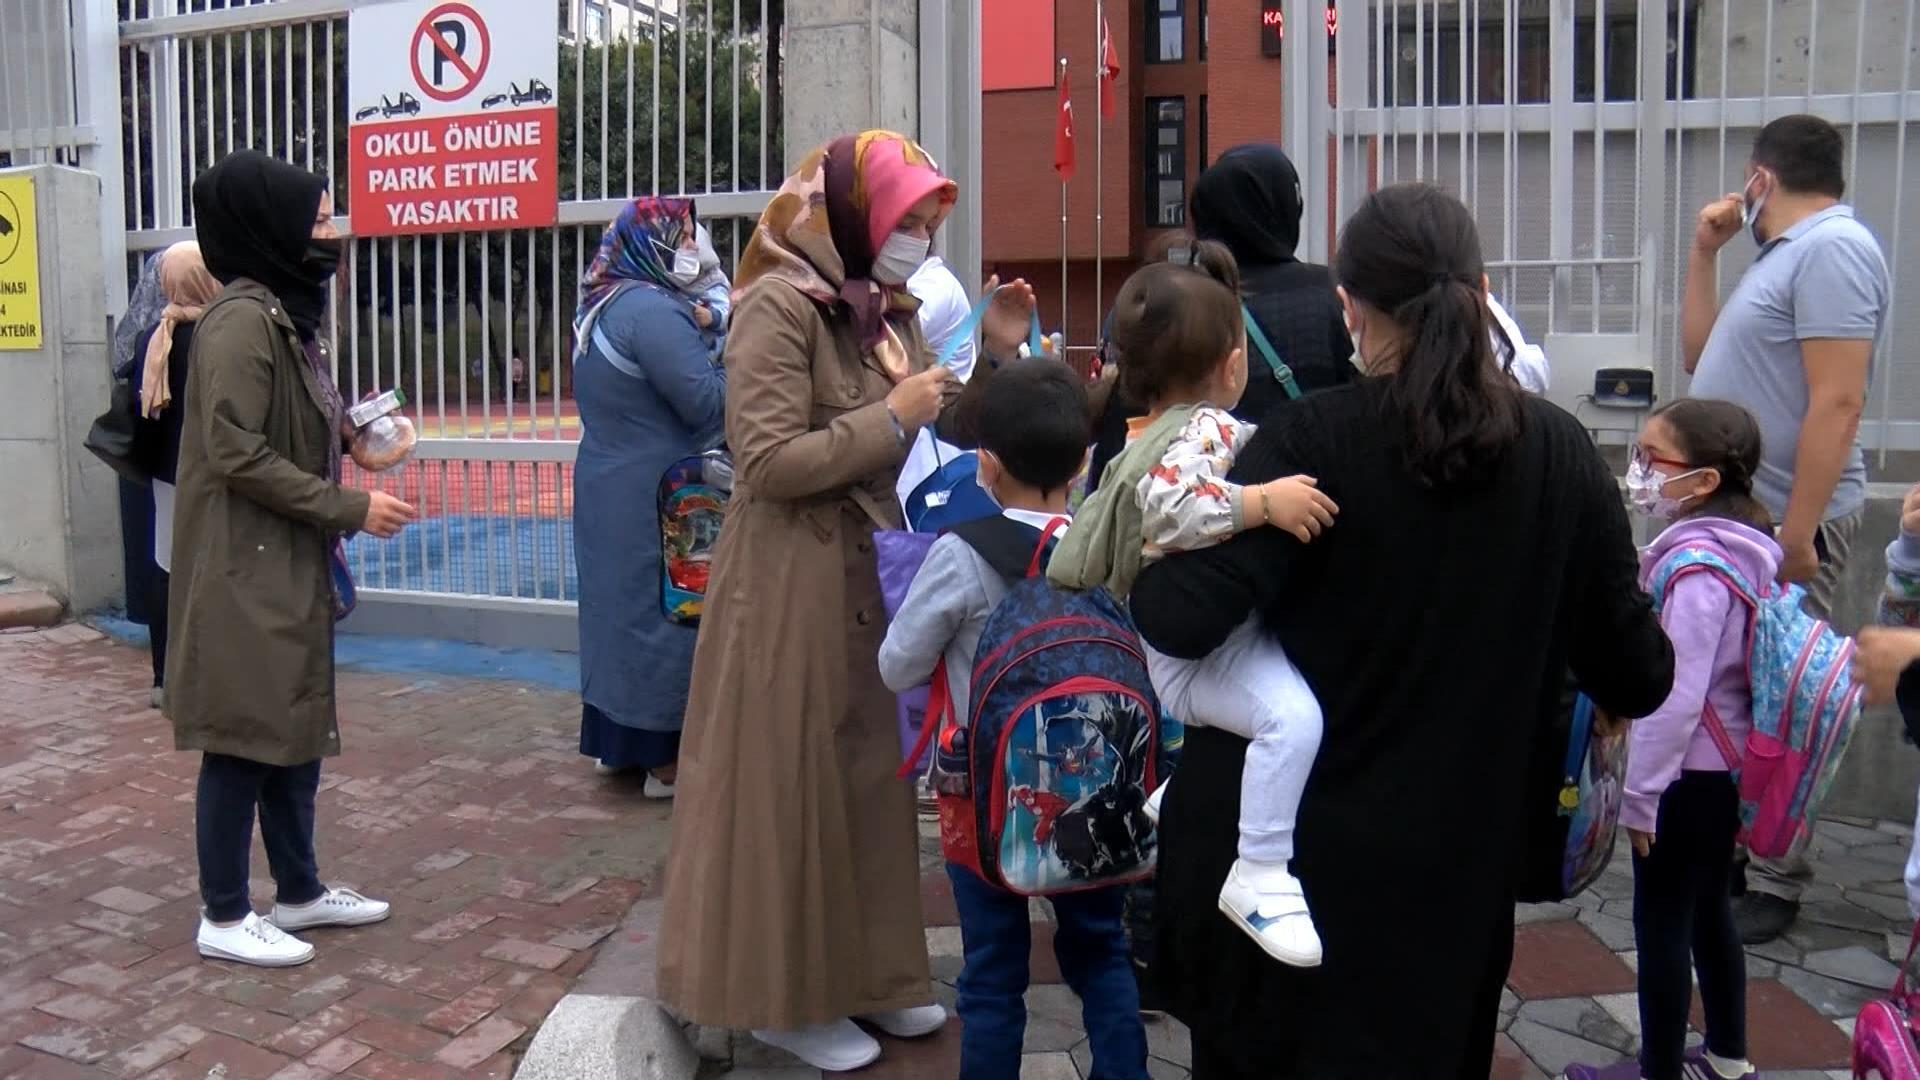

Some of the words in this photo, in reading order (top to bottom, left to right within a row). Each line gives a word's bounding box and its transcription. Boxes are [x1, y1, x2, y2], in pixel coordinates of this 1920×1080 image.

[365, 130, 437, 158] OKUL
[444, 120, 541, 151] ÖNÜNE
[368, 165, 436, 193] PARK
[444, 158, 539, 188] ETMEK
[386, 196, 519, 227] YASAKTIR
[0, 279, 27, 295] İNASI
[0, 322, 37, 337] KTEDİR
